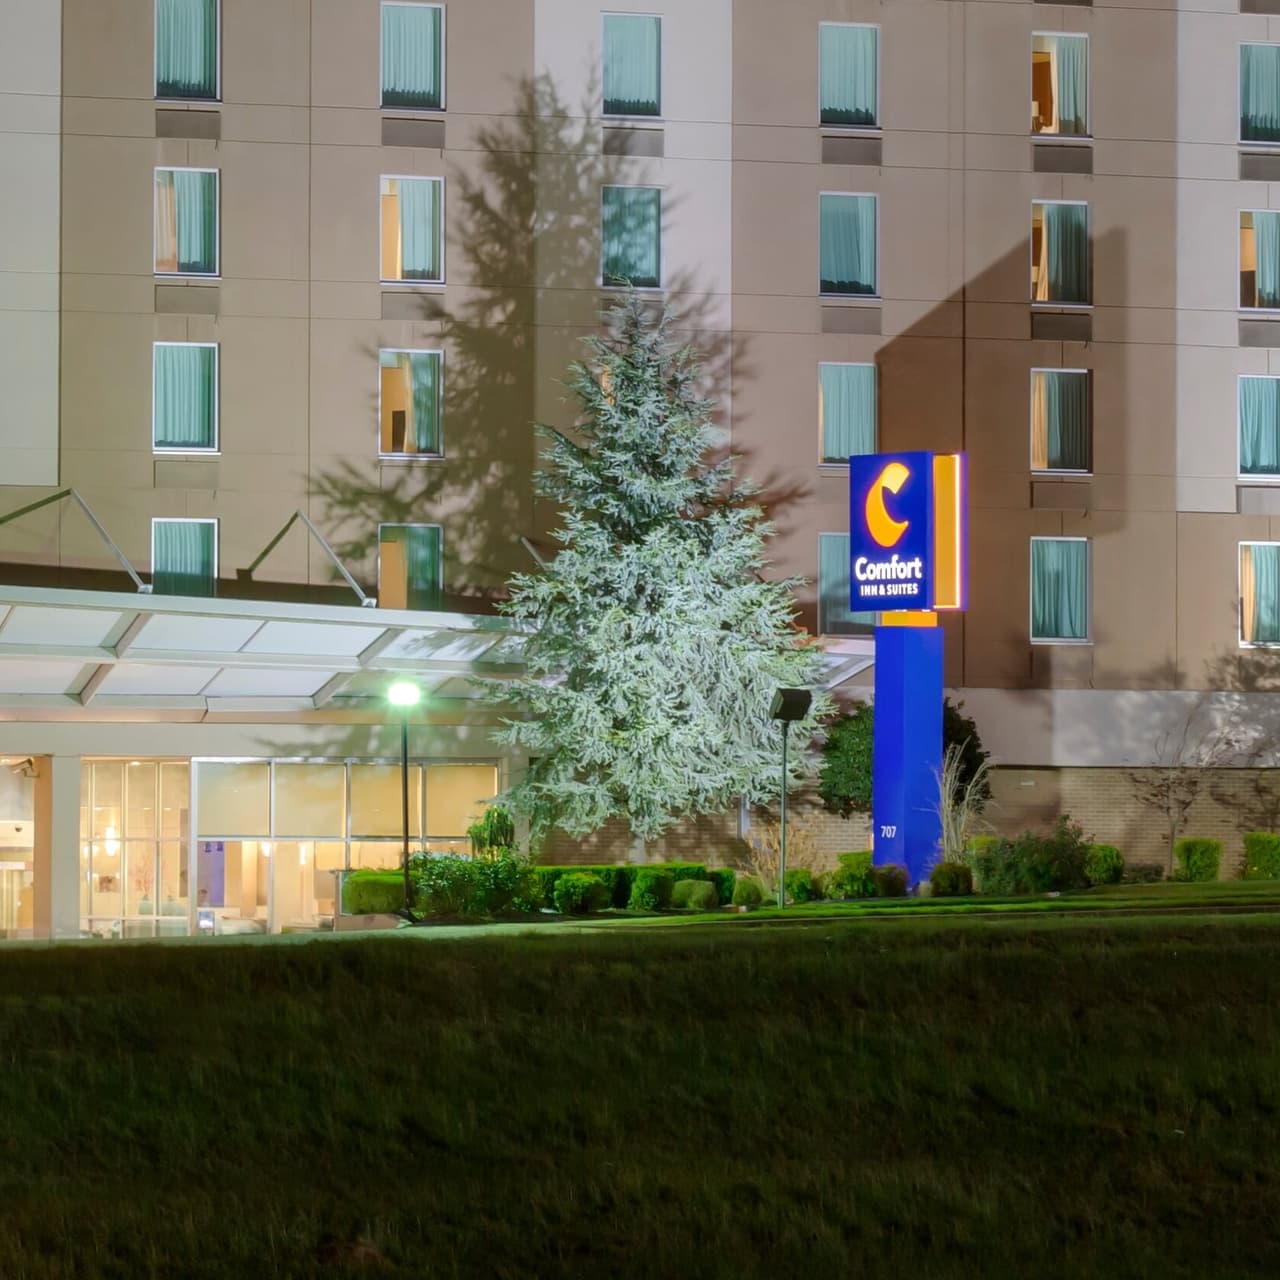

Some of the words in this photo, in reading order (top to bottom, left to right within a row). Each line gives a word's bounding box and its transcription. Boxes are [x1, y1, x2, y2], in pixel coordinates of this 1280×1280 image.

[855, 554, 923, 581] Comfort
[860, 584, 878, 596] INN
[878, 584, 886, 596] &
[886, 582, 919, 596] SUITES
[880, 825, 897, 839] 707
